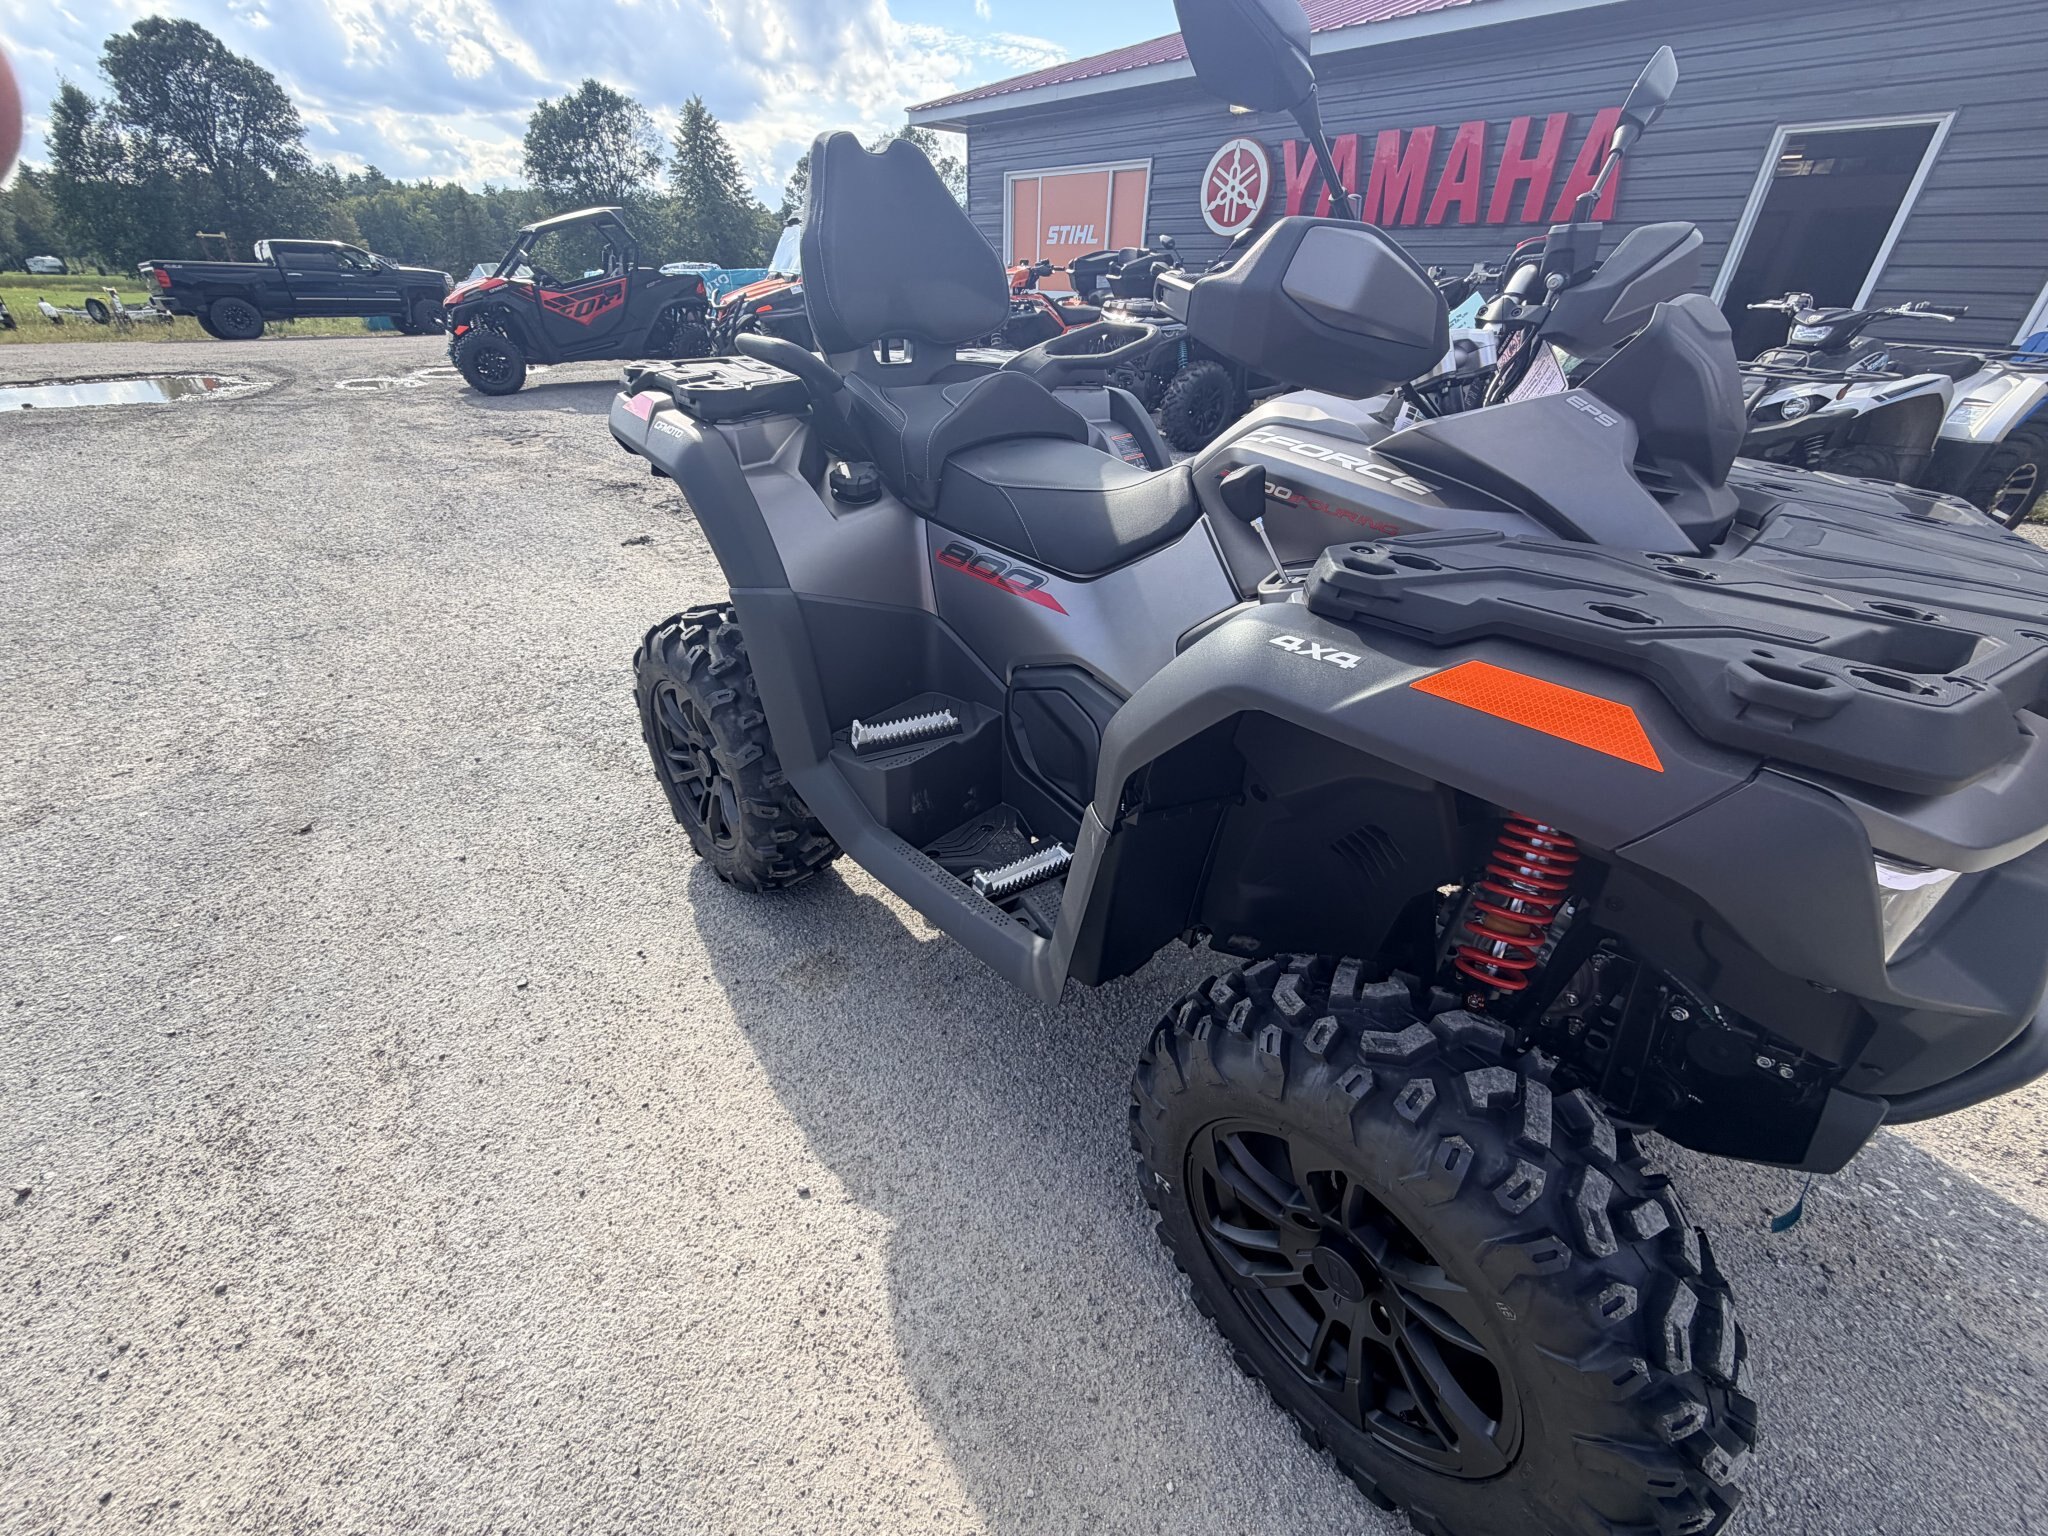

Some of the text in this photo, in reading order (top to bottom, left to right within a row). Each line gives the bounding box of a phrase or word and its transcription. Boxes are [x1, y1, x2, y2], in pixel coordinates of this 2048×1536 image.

[1282, 107, 1626, 226] YAMAHA
[1046, 224, 1098, 245] STIHL
[1565, 394, 1619, 427] EPS
[653, 420, 684, 439] CFMOTO
[938, 540, 1050, 594] 800
